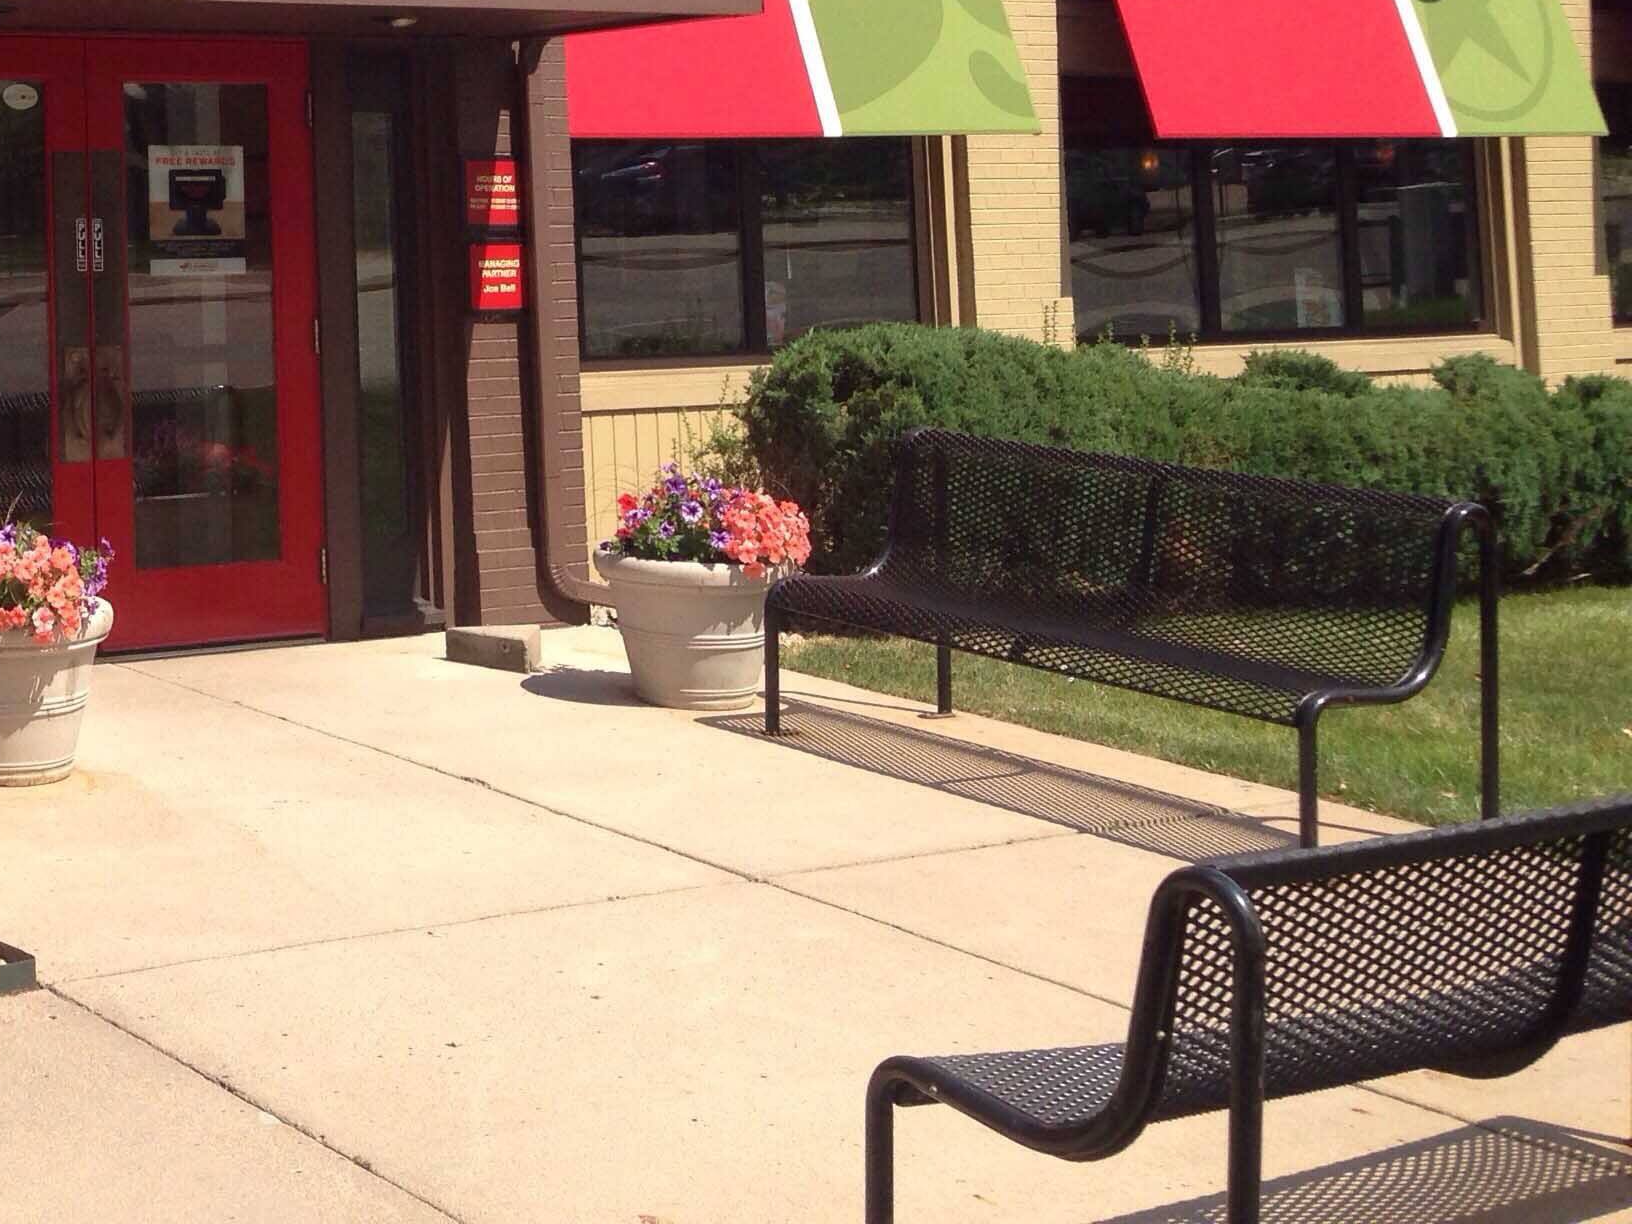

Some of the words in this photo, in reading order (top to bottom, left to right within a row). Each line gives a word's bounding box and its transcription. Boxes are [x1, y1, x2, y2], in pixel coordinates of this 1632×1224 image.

[155, 157, 183, 166] FREE
[476, 175, 502, 184] HOURS
[502, 175, 513, 184] OF
[474, 184, 516, 192] OPERATION
[94, 223, 102, 259] PULL
[481, 269, 517, 278] PARTNER
